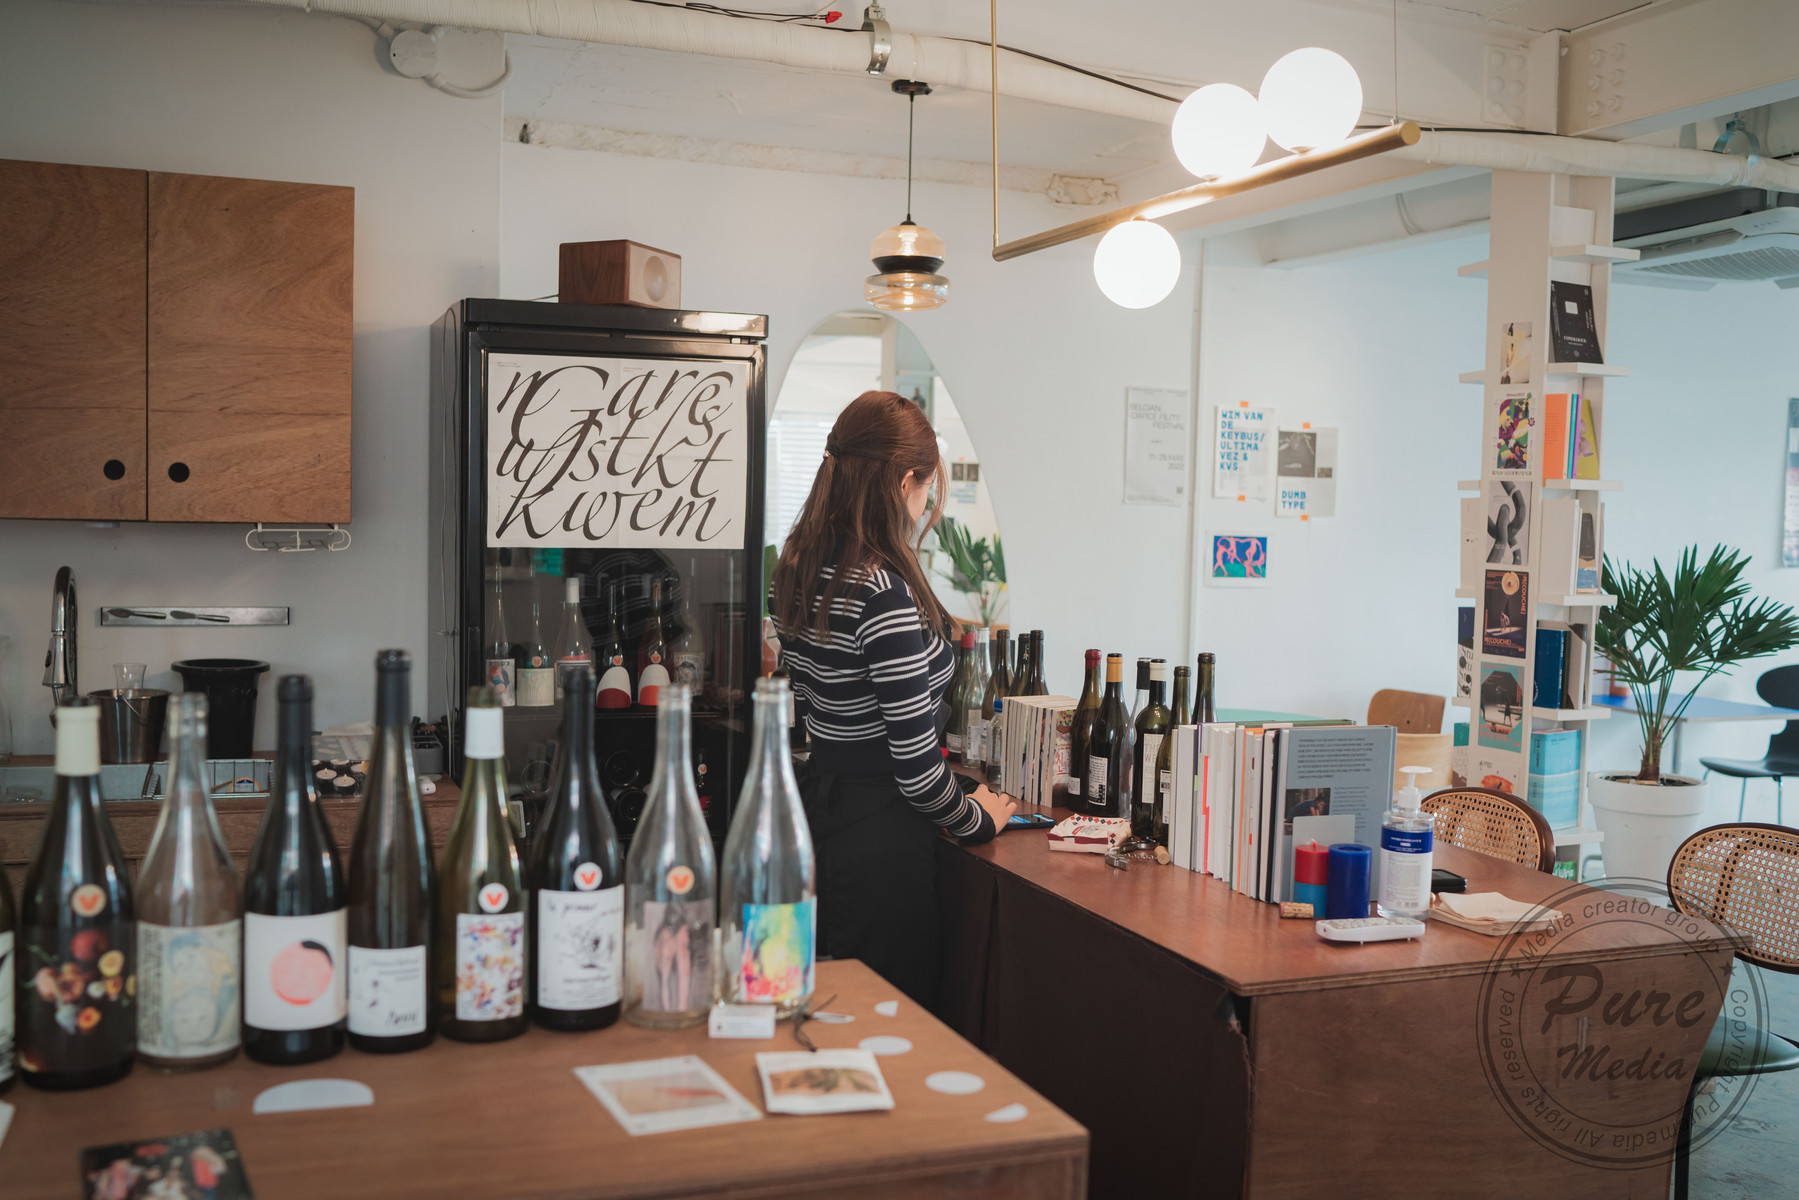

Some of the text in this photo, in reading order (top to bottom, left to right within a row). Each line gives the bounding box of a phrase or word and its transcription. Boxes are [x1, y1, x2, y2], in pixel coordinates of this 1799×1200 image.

[1221, 410, 1264, 421] WIM VAN
[1221, 420, 1233, 429] DE
[1219, 441, 1259, 451] ULTIMA
[1219, 452, 1239, 461] VEZ
[1219, 461, 1239, 471] KVS
[1281, 490, 1307, 500] DUMB
[1281, 500, 1306, 510] TYPE
